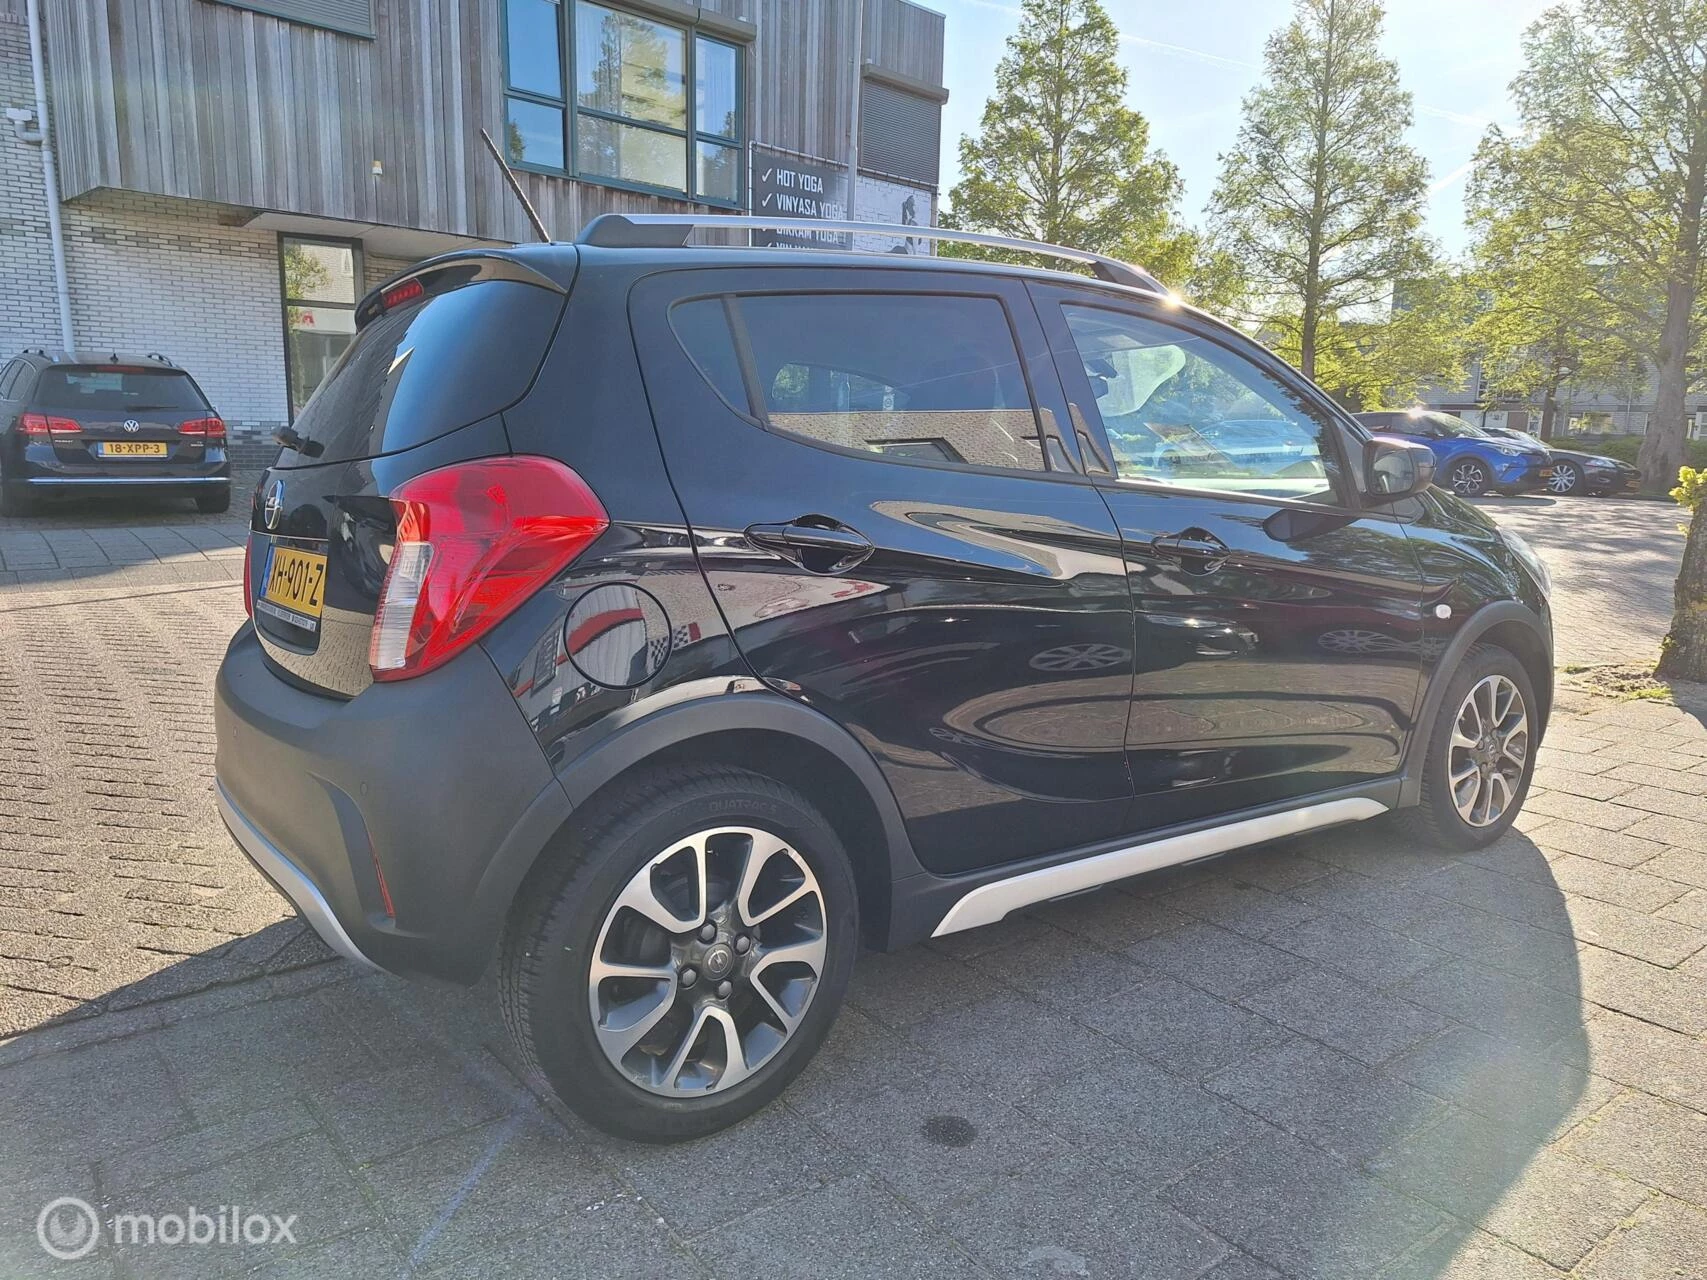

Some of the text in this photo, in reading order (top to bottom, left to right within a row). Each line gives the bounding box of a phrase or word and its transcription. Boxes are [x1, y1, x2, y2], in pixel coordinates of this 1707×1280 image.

[776, 168, 823, 194] HOT YOGA
[776, 193, 845, 220] VINYASA YOGA
[815, 230, 839, 244] YOGA
[109, 443, 161, 454] 18-XPP-3
[268, 553, 324, 607] XH-901-Z
